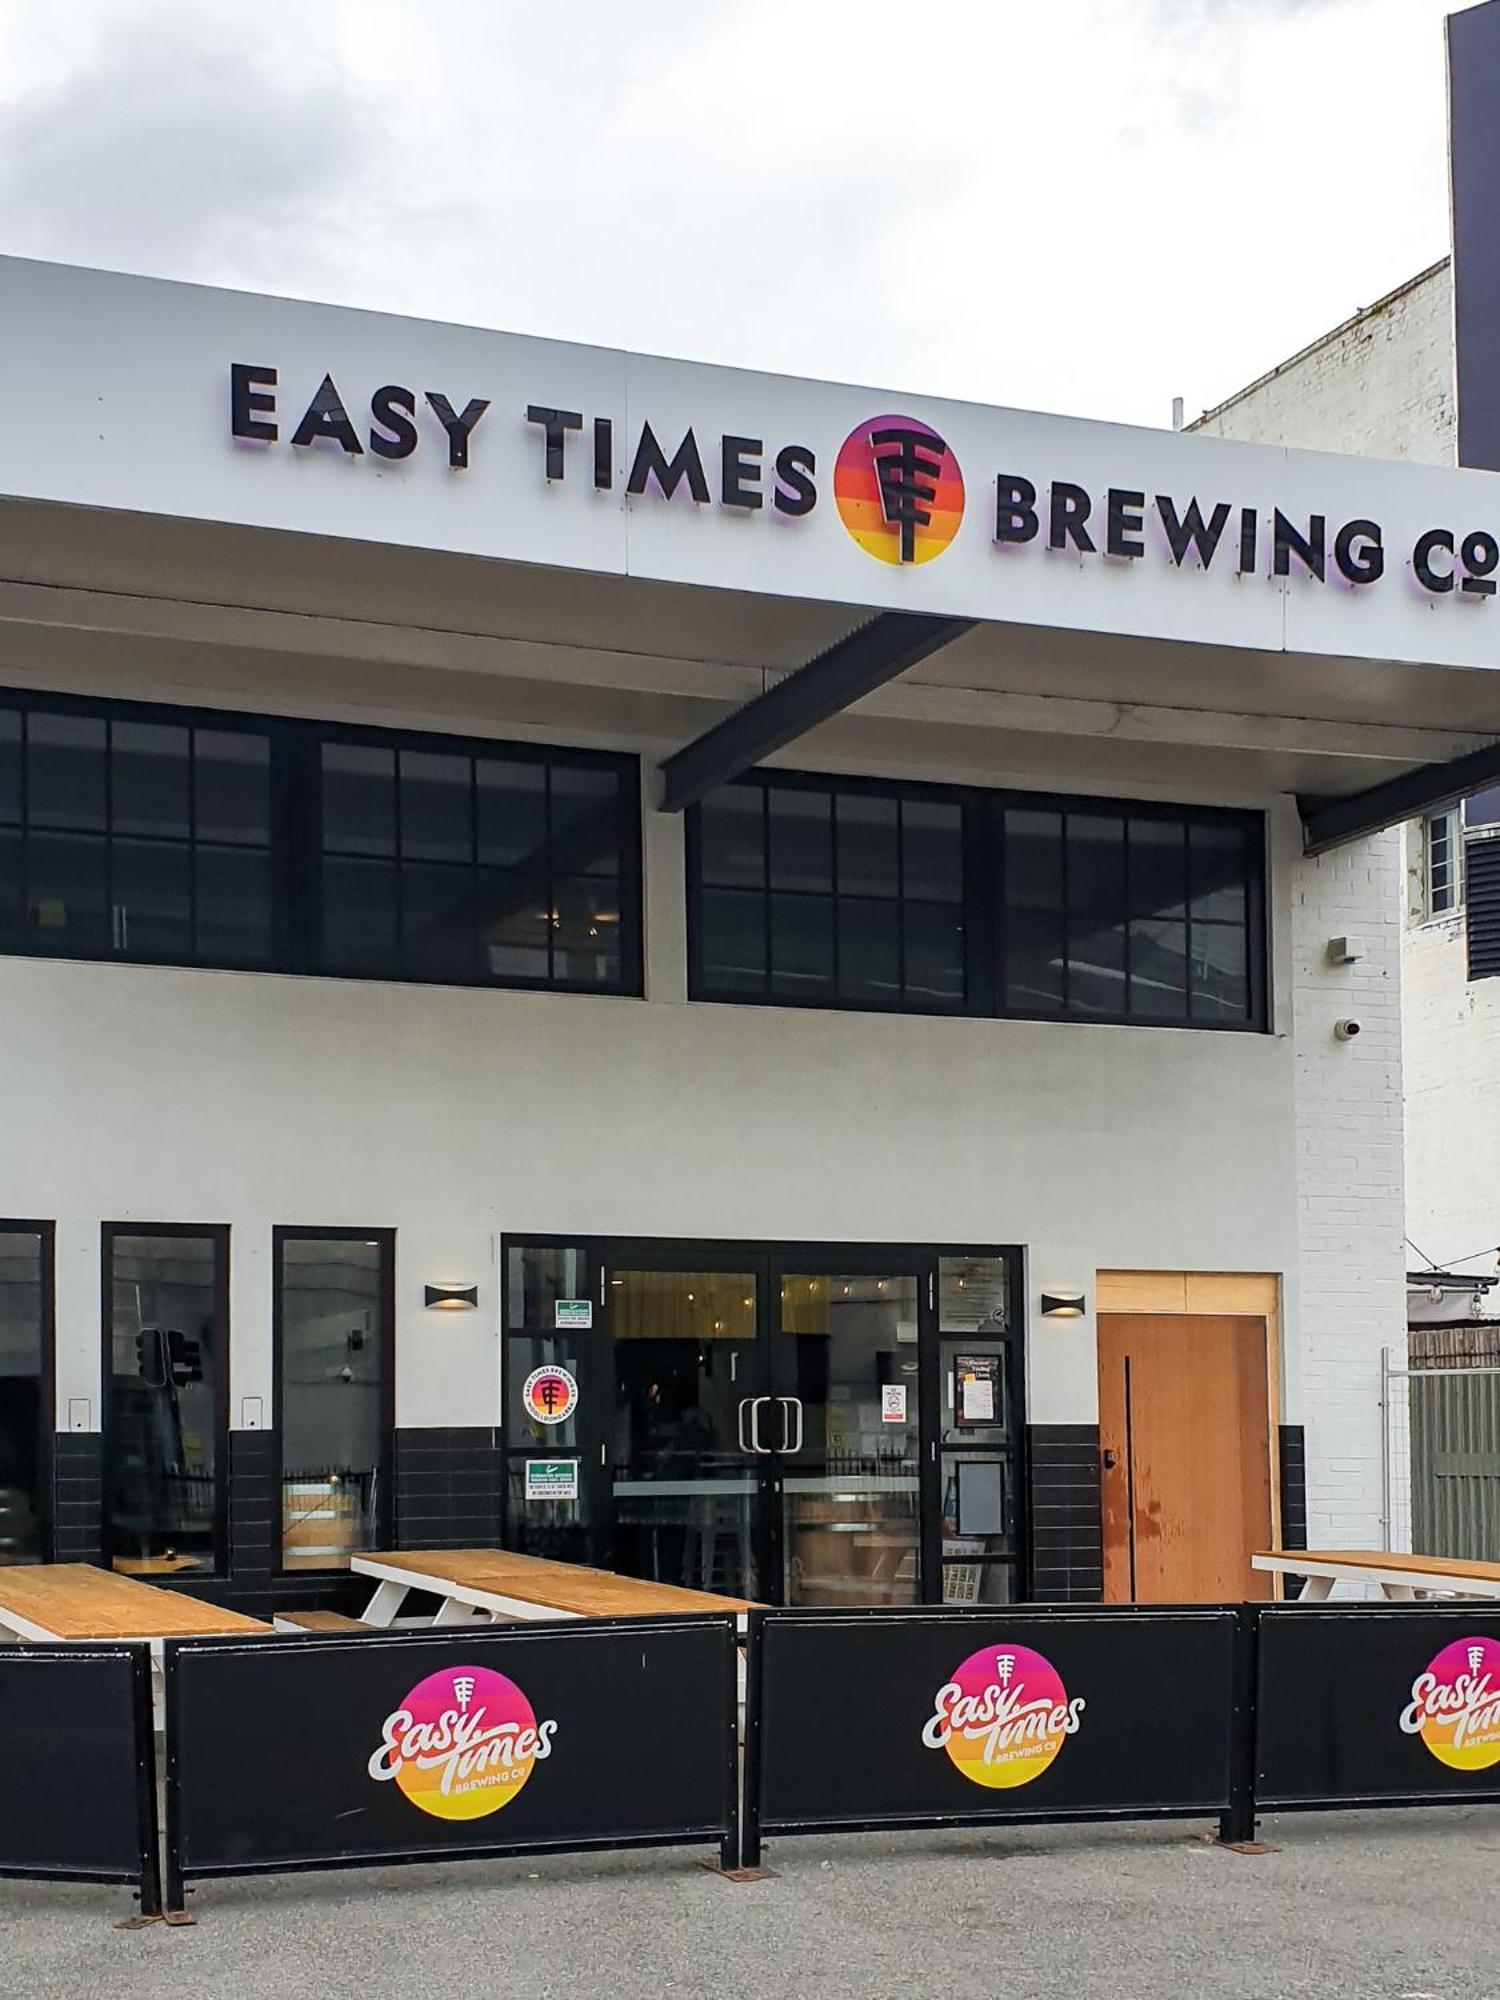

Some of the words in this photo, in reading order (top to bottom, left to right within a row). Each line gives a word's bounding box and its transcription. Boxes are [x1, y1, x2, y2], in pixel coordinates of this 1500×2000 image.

[230, 362, 491, 470] EASY
[526, 404, 818, 517] TIMES
[995, 473, 1385, 585] BREWING
[922, 1682, 1025, 1749] Easy
[963, 1697, 1086, 1767] Times
[1399, 1672, 1493, 1735] Easy
[368, 1707, 487, 1781] Easy
[416, 1720, 558, 1797] Times
[996, 1744, 1043, 1762] BREWING
[456, 1771, 510, 1793] BREWING
